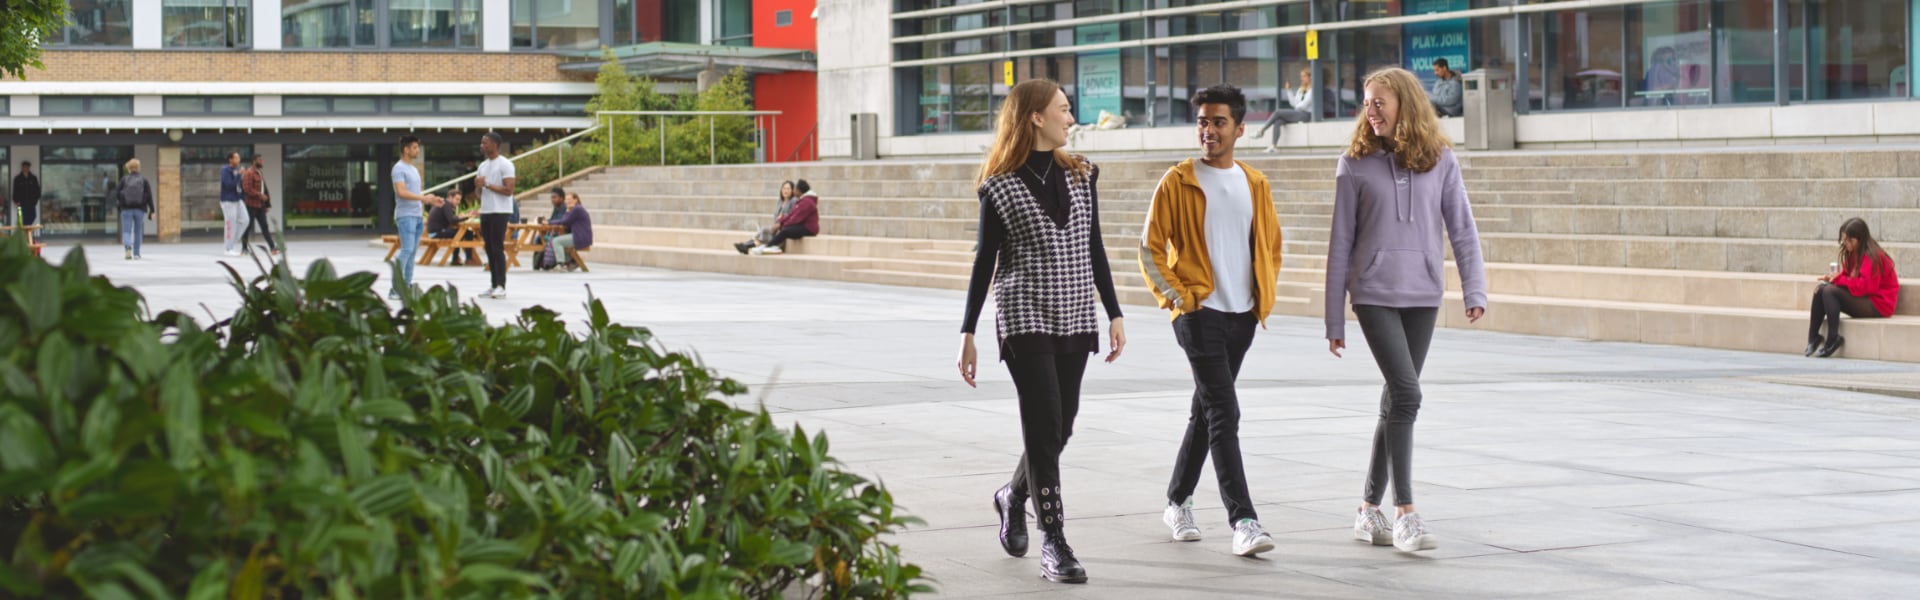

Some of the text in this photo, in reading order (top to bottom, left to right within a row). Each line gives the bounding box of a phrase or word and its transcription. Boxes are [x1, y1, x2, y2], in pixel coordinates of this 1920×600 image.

[1412, 32, 1466, 50] PLAY. JOIN.
[319, 190, 344, 201] Hub
